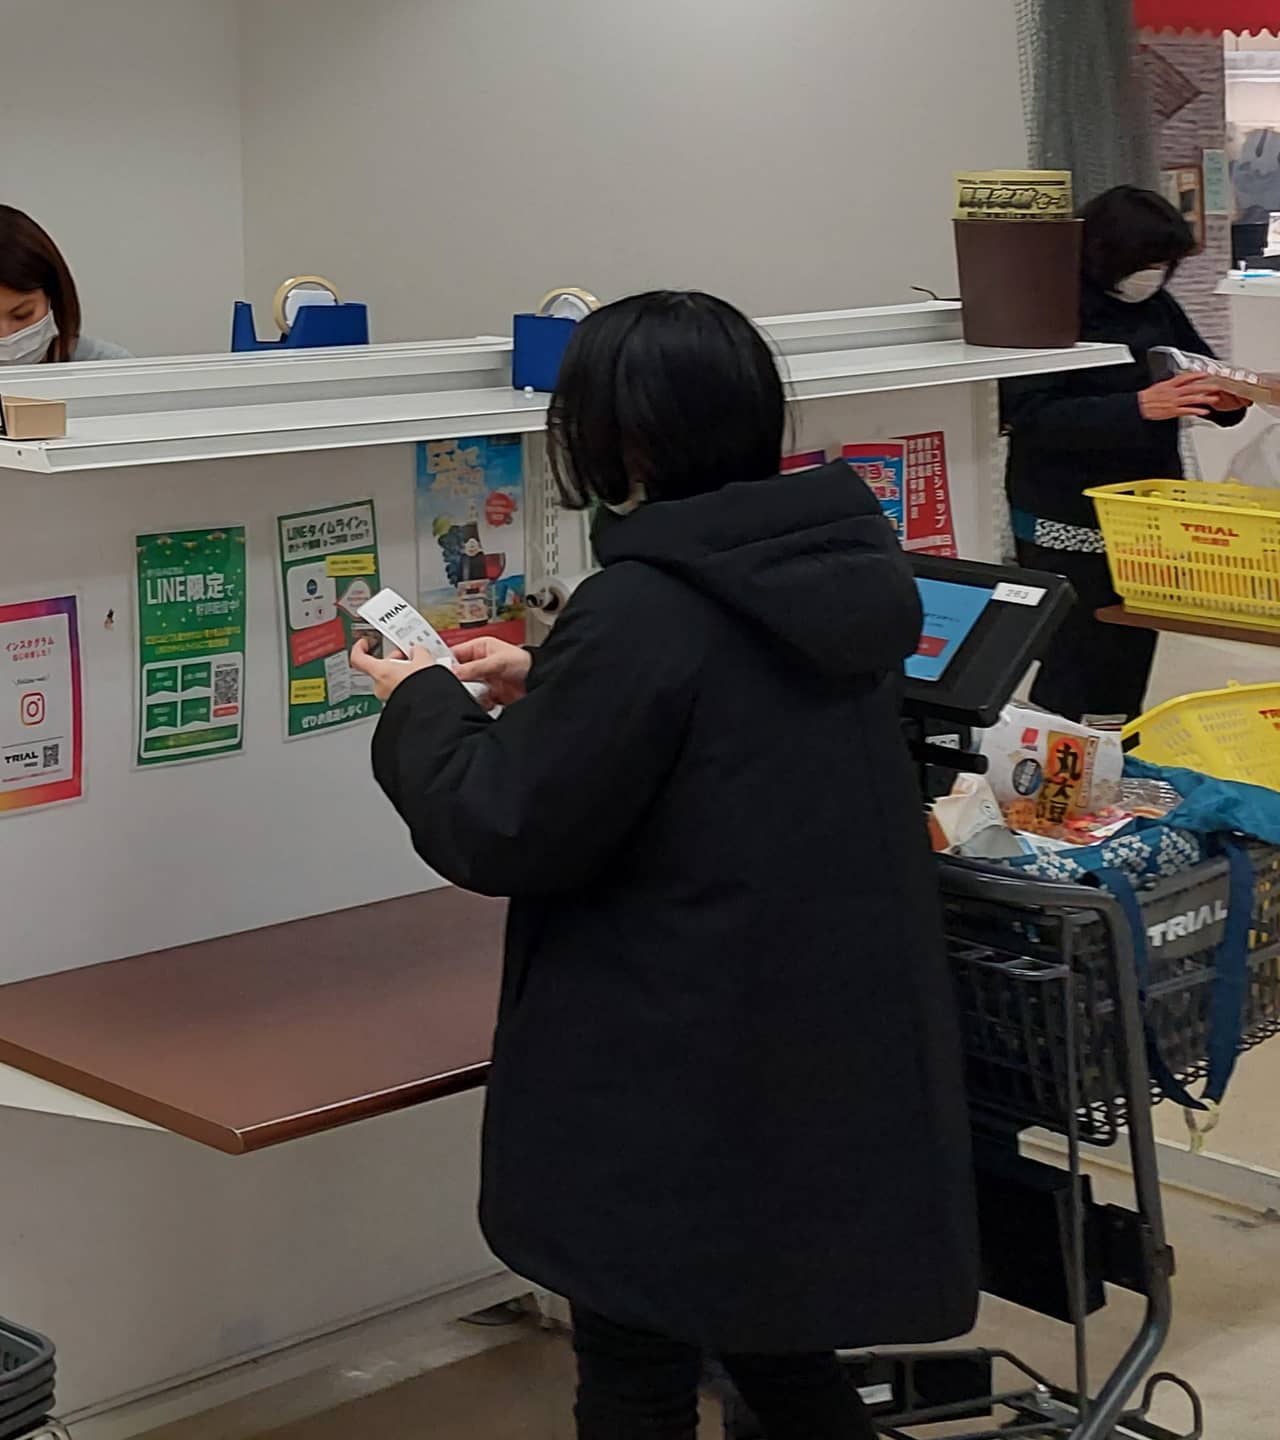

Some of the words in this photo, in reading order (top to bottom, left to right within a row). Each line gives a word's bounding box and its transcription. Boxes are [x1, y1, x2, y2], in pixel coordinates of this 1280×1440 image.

[1180, 522, 1240, 537] TRIAL
[378, 603, 408, 624] TRIAL
[4, 751, 39, 764] TRIAL
[1051, 742, 1082, 825] 丸大豆
[1146, 900, 1228, 947] TRIAL
